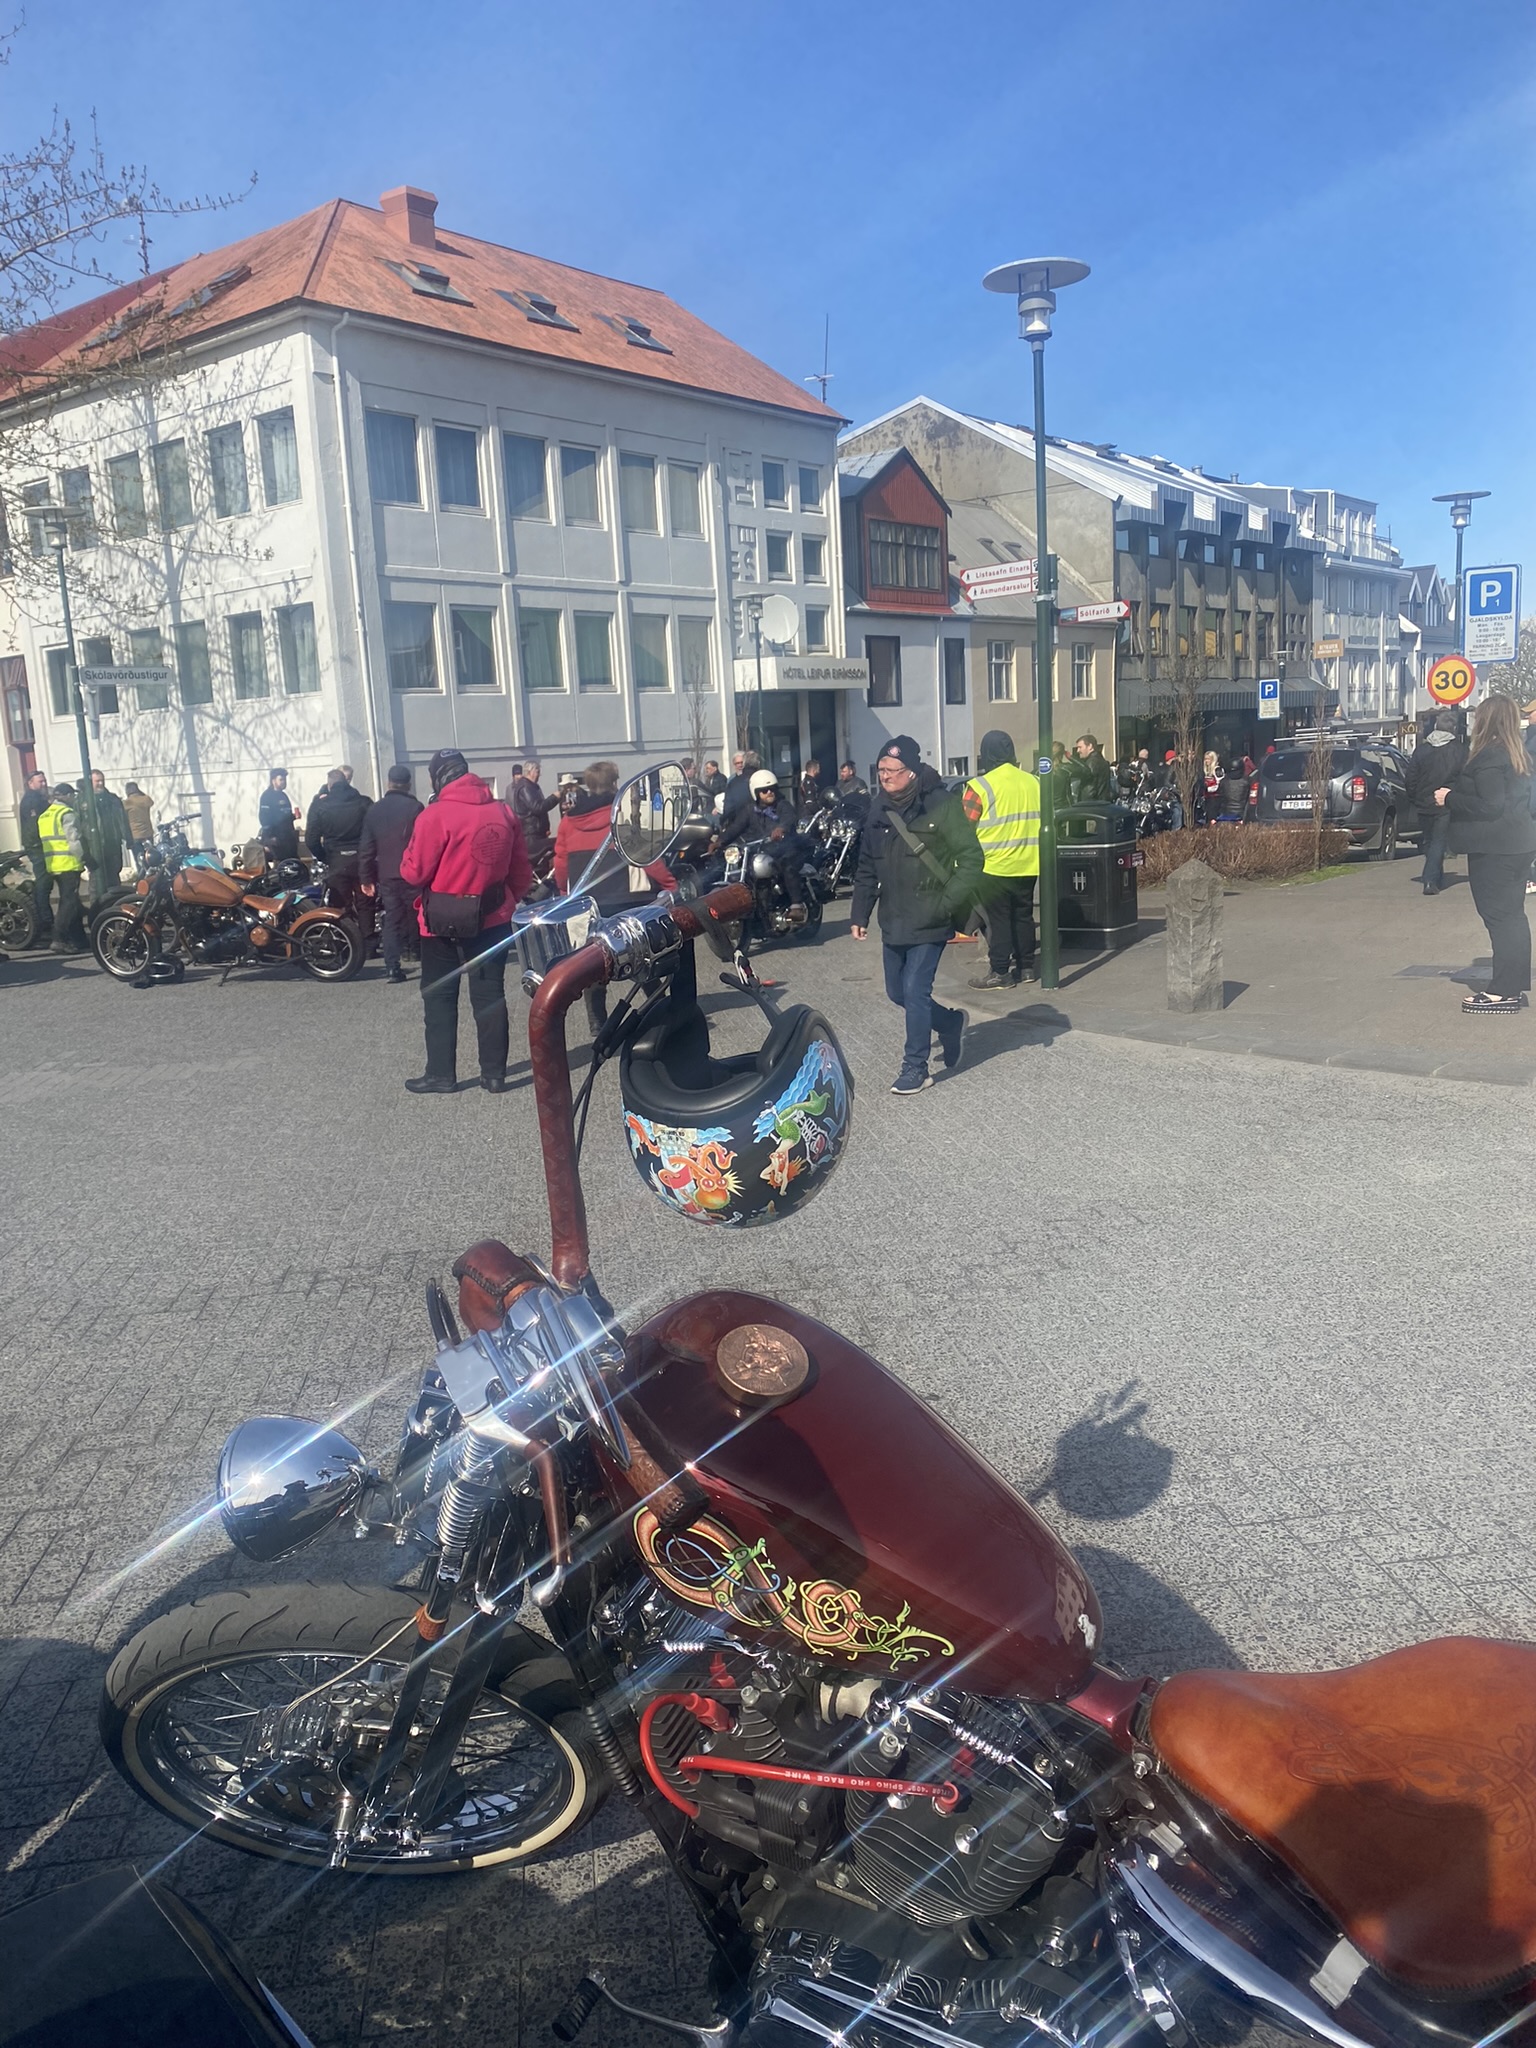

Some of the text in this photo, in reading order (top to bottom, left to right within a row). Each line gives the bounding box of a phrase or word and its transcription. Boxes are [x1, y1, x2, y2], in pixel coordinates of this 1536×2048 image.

[976, 565, 1030, 578] Listasafn Einars
[980, 583, 1030, 595] Ásmundarsalur
[1480, 580, 1502, 608] P
[1080, 608, 1110, 617] Sólfarið
[84, 670, 168, 682] Skólavörðustígur
[1435, 670, 1468, 690] 30
[1265, 684, 1274, 696] P
[784, 1770, 811, 1780] WIRE
[817, 1775, 844, 1784] RACE
[876, 1781, 903, 1790] SPIRO
